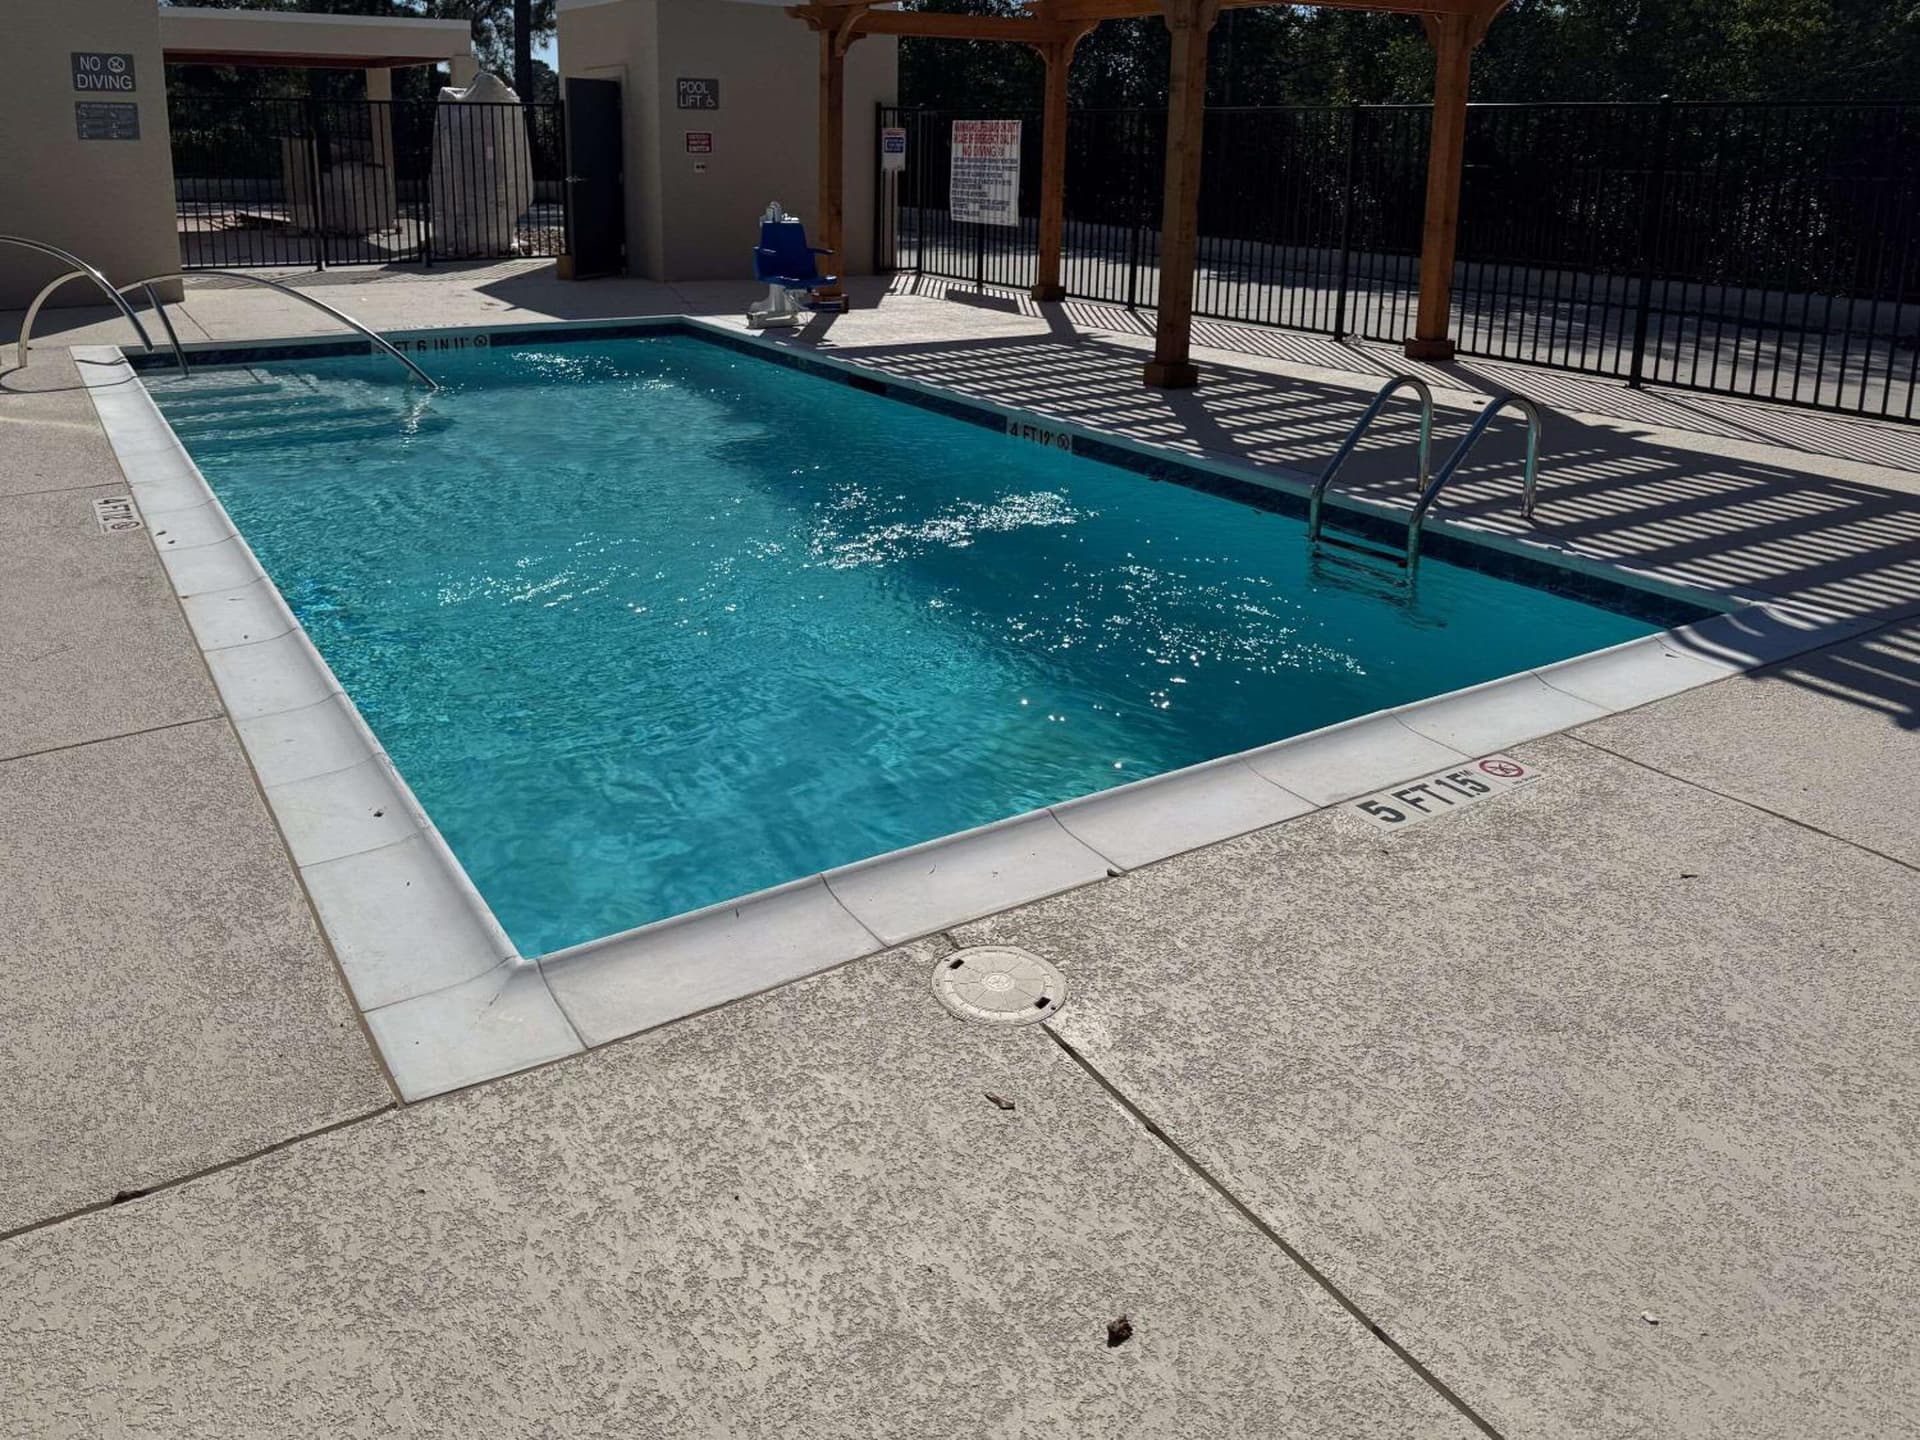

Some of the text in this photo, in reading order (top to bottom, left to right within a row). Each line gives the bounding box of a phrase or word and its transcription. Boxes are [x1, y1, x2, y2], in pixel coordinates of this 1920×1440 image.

[80, 56, 100, 71] NO
[77, 74, 132, 90] DIVING
[680, 81, 709, 94] POOL
[680, 95, 702, 107] LIFT
[1010, 422, 1018, 437] 4
[1023, 425, 1037, 443] FT
[1356, 800, 1406, 823] 5
[1391, 783, 1455, 813] FT
